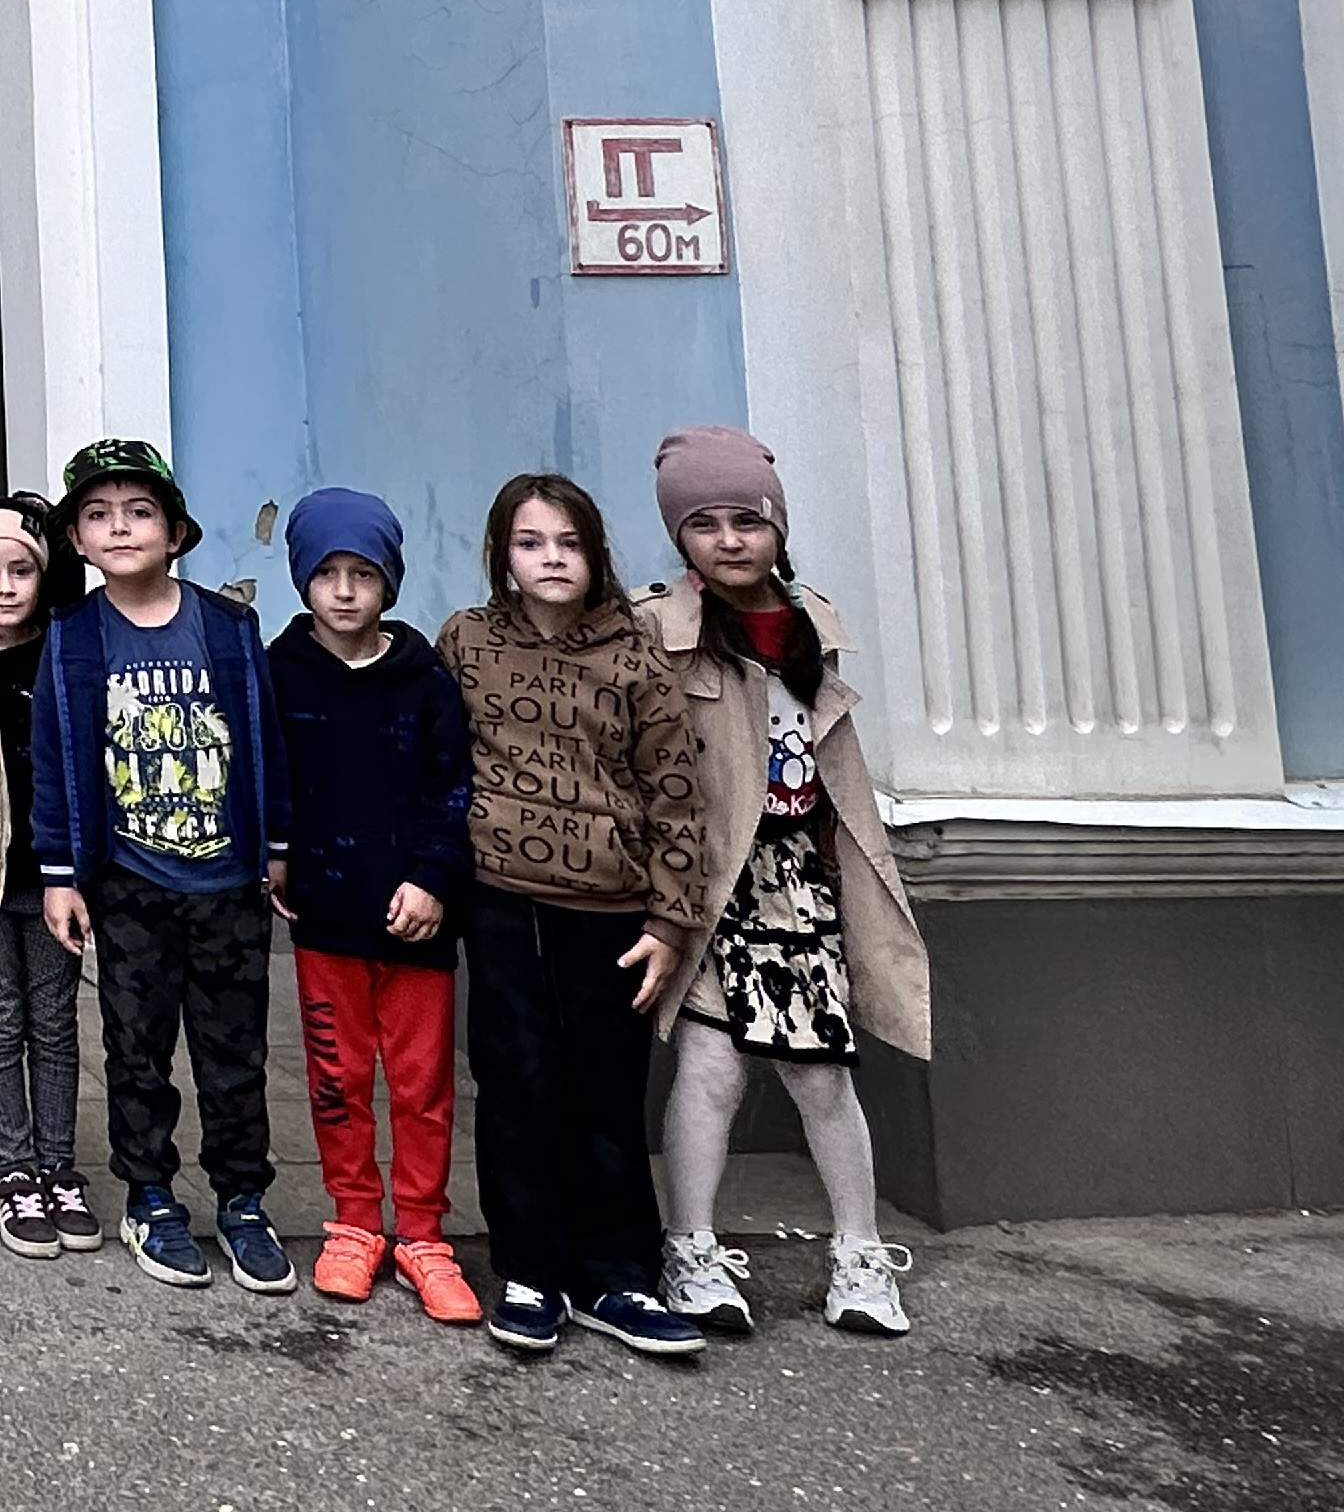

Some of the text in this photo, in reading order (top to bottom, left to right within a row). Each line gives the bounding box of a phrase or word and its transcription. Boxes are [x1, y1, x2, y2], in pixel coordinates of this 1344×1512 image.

[483, 693, 579, 730] SOU
[487, 764, 581, 806] SOU
[492, 827, 592, 874] SOU
